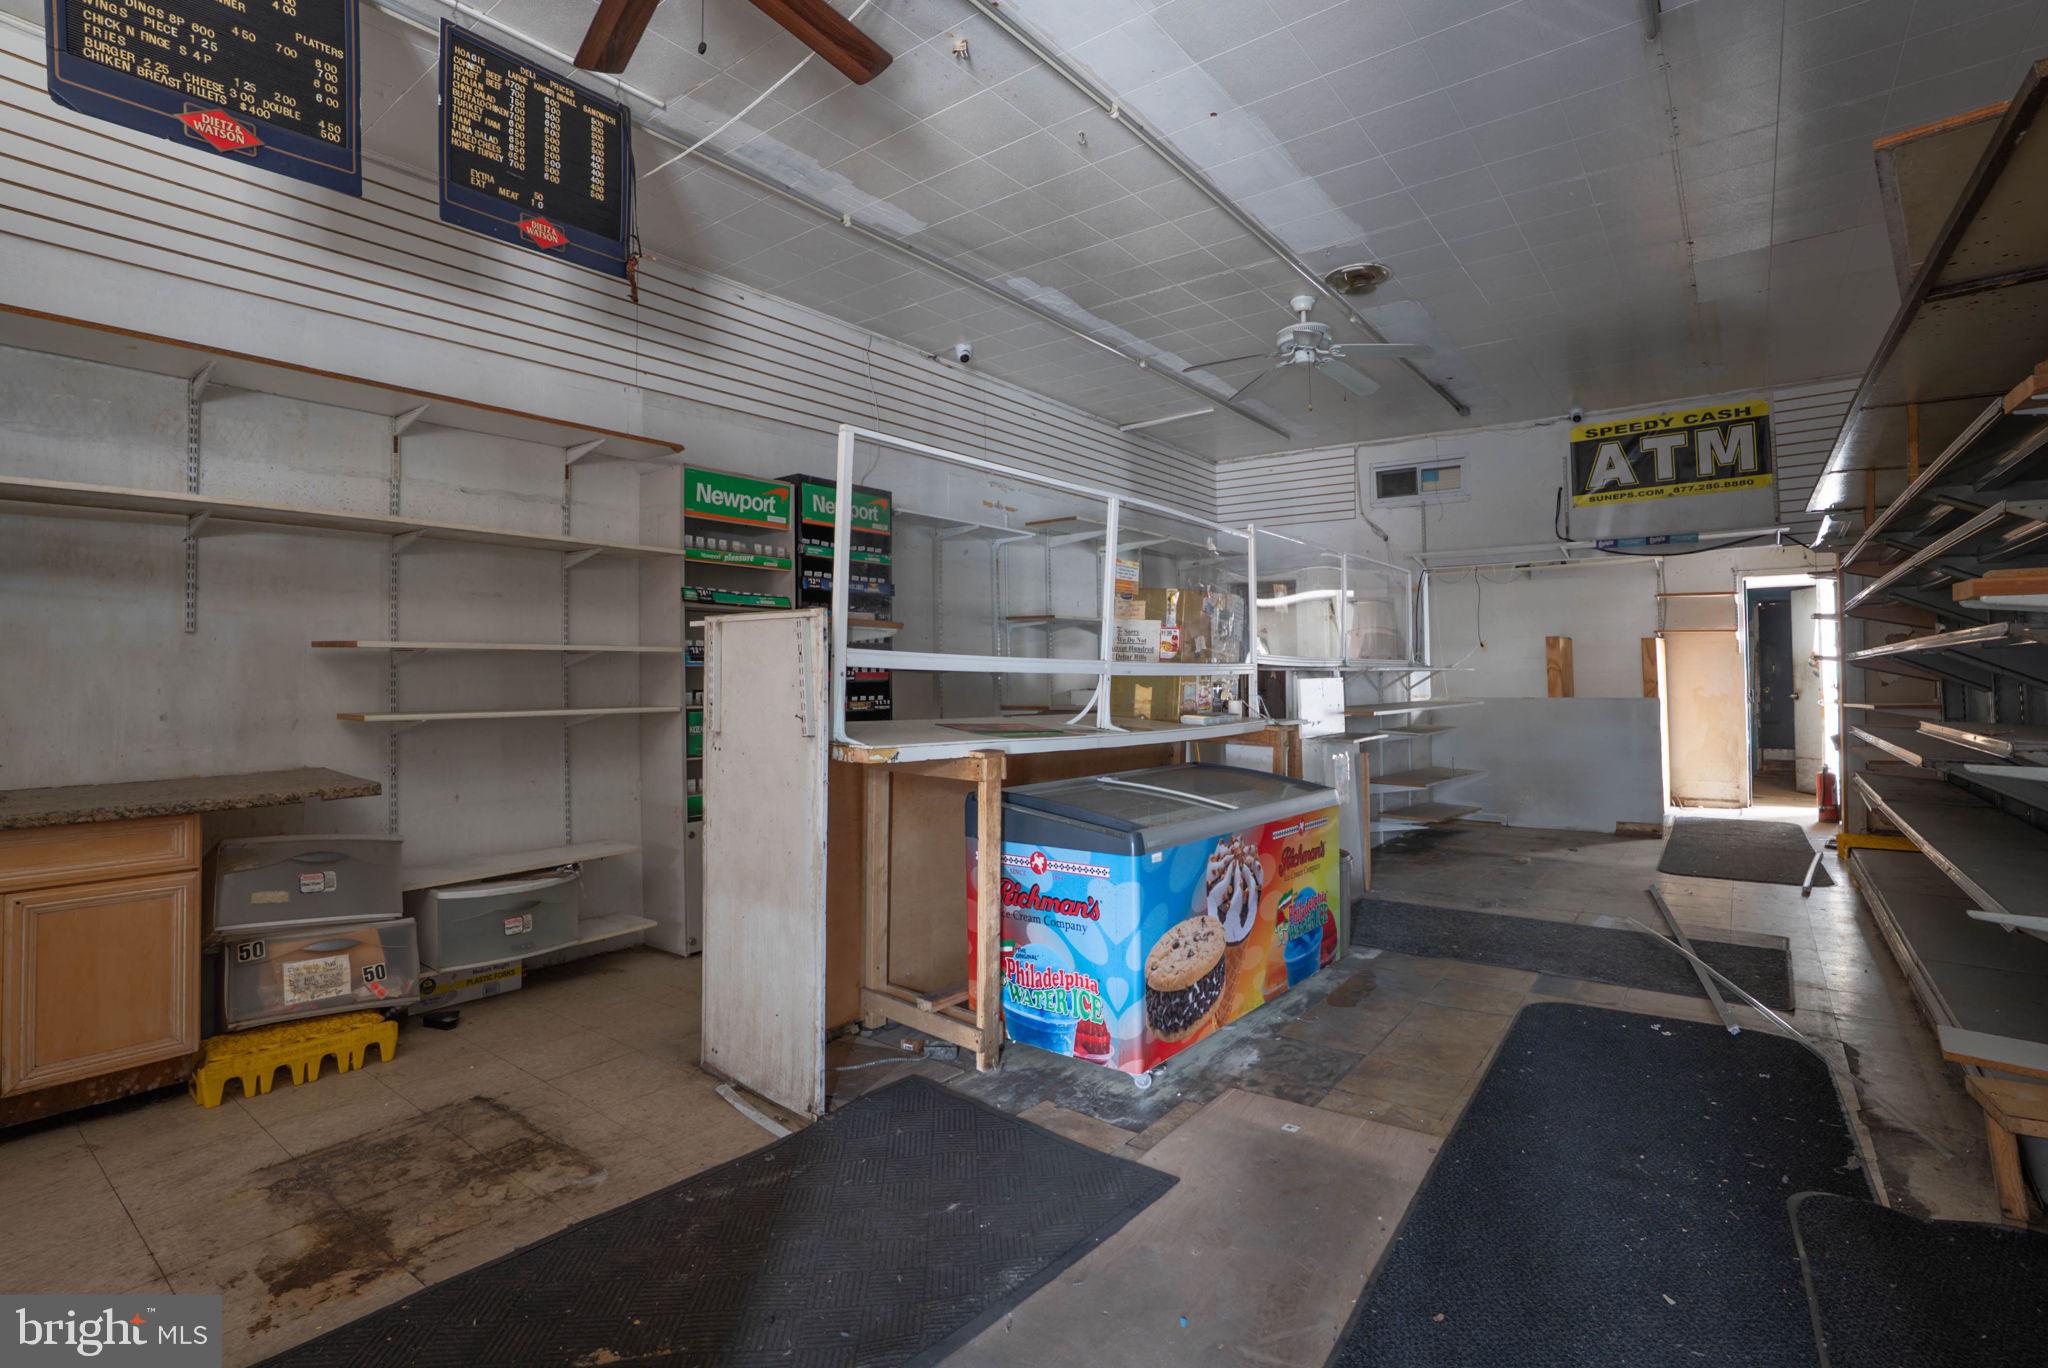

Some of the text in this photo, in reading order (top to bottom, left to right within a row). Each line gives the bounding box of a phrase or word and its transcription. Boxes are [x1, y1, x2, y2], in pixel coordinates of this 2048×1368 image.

[83, 10, 120, 32] CHICK
[144, 16, 178, 37] PIECE
[84, 22, 126, 46] FRIES
[295, 32, 344, 59] PLATTERS
[83, 48, 131, 72] CHIKEN
[136, 66, 182, 90] BREAST
[186, 84, 228, 106] FILLETS
[84, 36, 136, 63] BURGER
[183, 72, 226, 94] CHEESE
[262, 100, 302, 120] DOUBLE
[453, 56, 482, 74] CORNED
[486, 70, 503, 82] BEEF
[453, 64, 478, 80] ROAST
[452, 73, 484, 92] ITALIAN
[454, 46, 486, 66] HOAGIE
[582, 105, 616, 126] SANDWICH
[520, 66, 574, 98] DELI PRICES
[452, 96, 484, 115] TURKEY
[474, 88, 496, 104] SALAD
[452, 104, 482, 122] TURKEY
[452, 113, 471, 126] HAM
[193, 120, 244, 144] WATSON
[451, 128, 478, 144] MIXED
[474, 129, 498, 144] SALAD
[450, 136, 476, 153] HONEY
[477, 146, 504, 163] TURKEY
[470, 168, 496, 184] EXTRA
[498, 186, 520, 200] MEAT
[526, 226, 558, 243] WATSON
[1586, 406, 1752, 438] SPEEDY CASH
[1585, 422, 1758, 491] ATM
[696, 482, 776, 514] Newport
[1589, 488, 1664, 503] SUNEPS.COM
[724, 553, 754, 562] pleasure
[1128, 645, 1154, 653] Hundred
[1000, 878, 1100, 921] Richman's
[1013, 910, 1041, 924] Cream
[1044, 916, 1088, 936] Company
[240, 942, 264, 960] 50
[363, 964, 386, 982] 50
[466, 968, 516, 986] PLASTIC FORKS
[1006, 956, 1099, 995] Philadelphia
[1008, 982, 1103, 1024] WATER ICE
